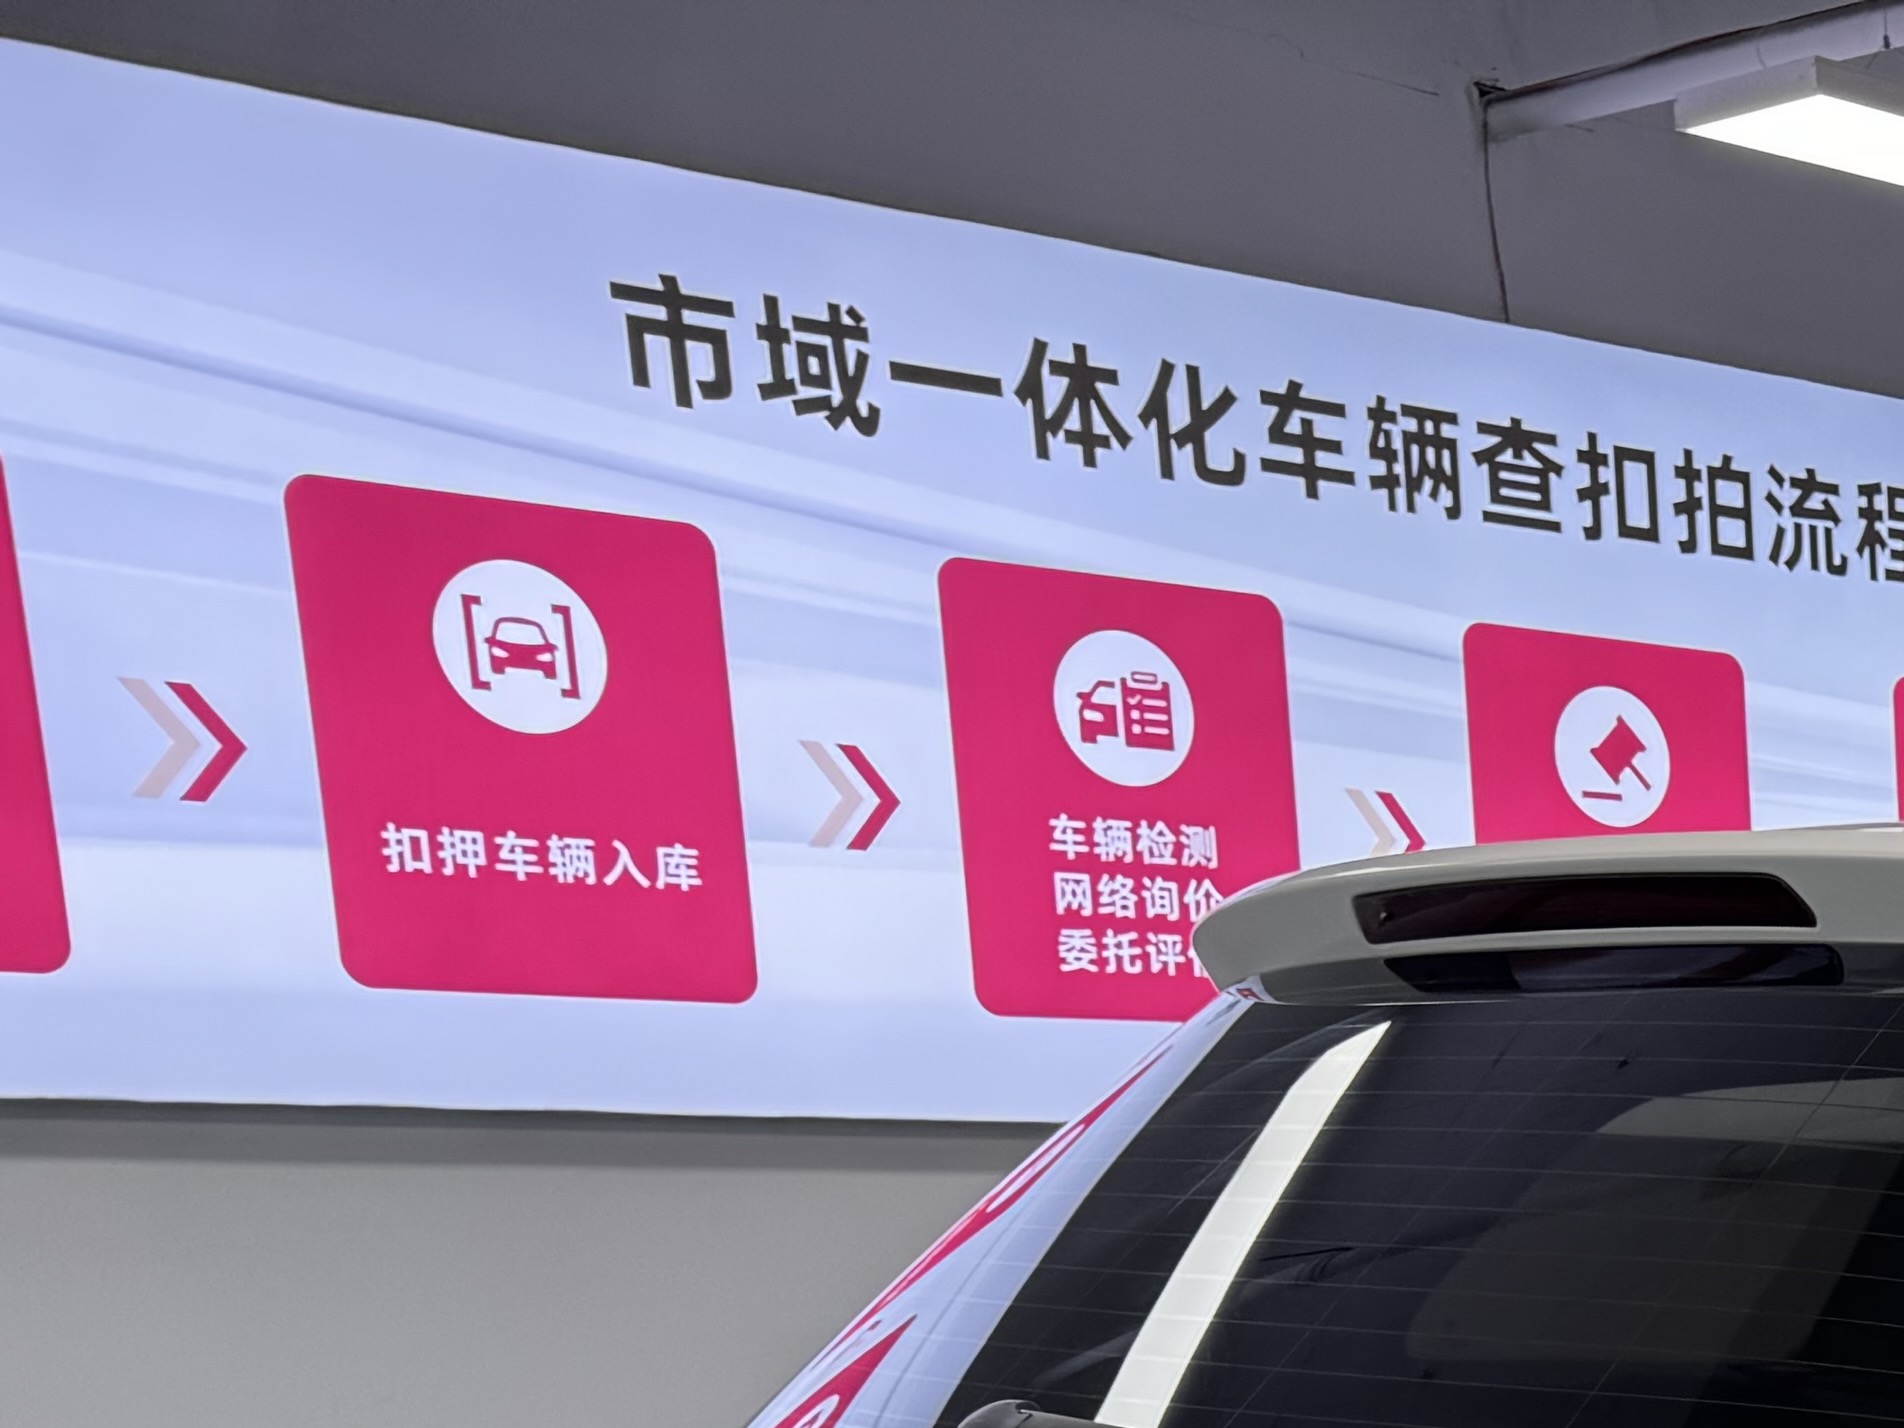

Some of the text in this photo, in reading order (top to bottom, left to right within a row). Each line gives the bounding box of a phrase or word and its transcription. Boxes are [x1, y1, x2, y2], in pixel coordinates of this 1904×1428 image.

[380, 822, 703, 894] 扣押车辆入库
[1048, 812, 1219, 870] 车辆检测
[1053, 870, 1225, 922] 网络询价
